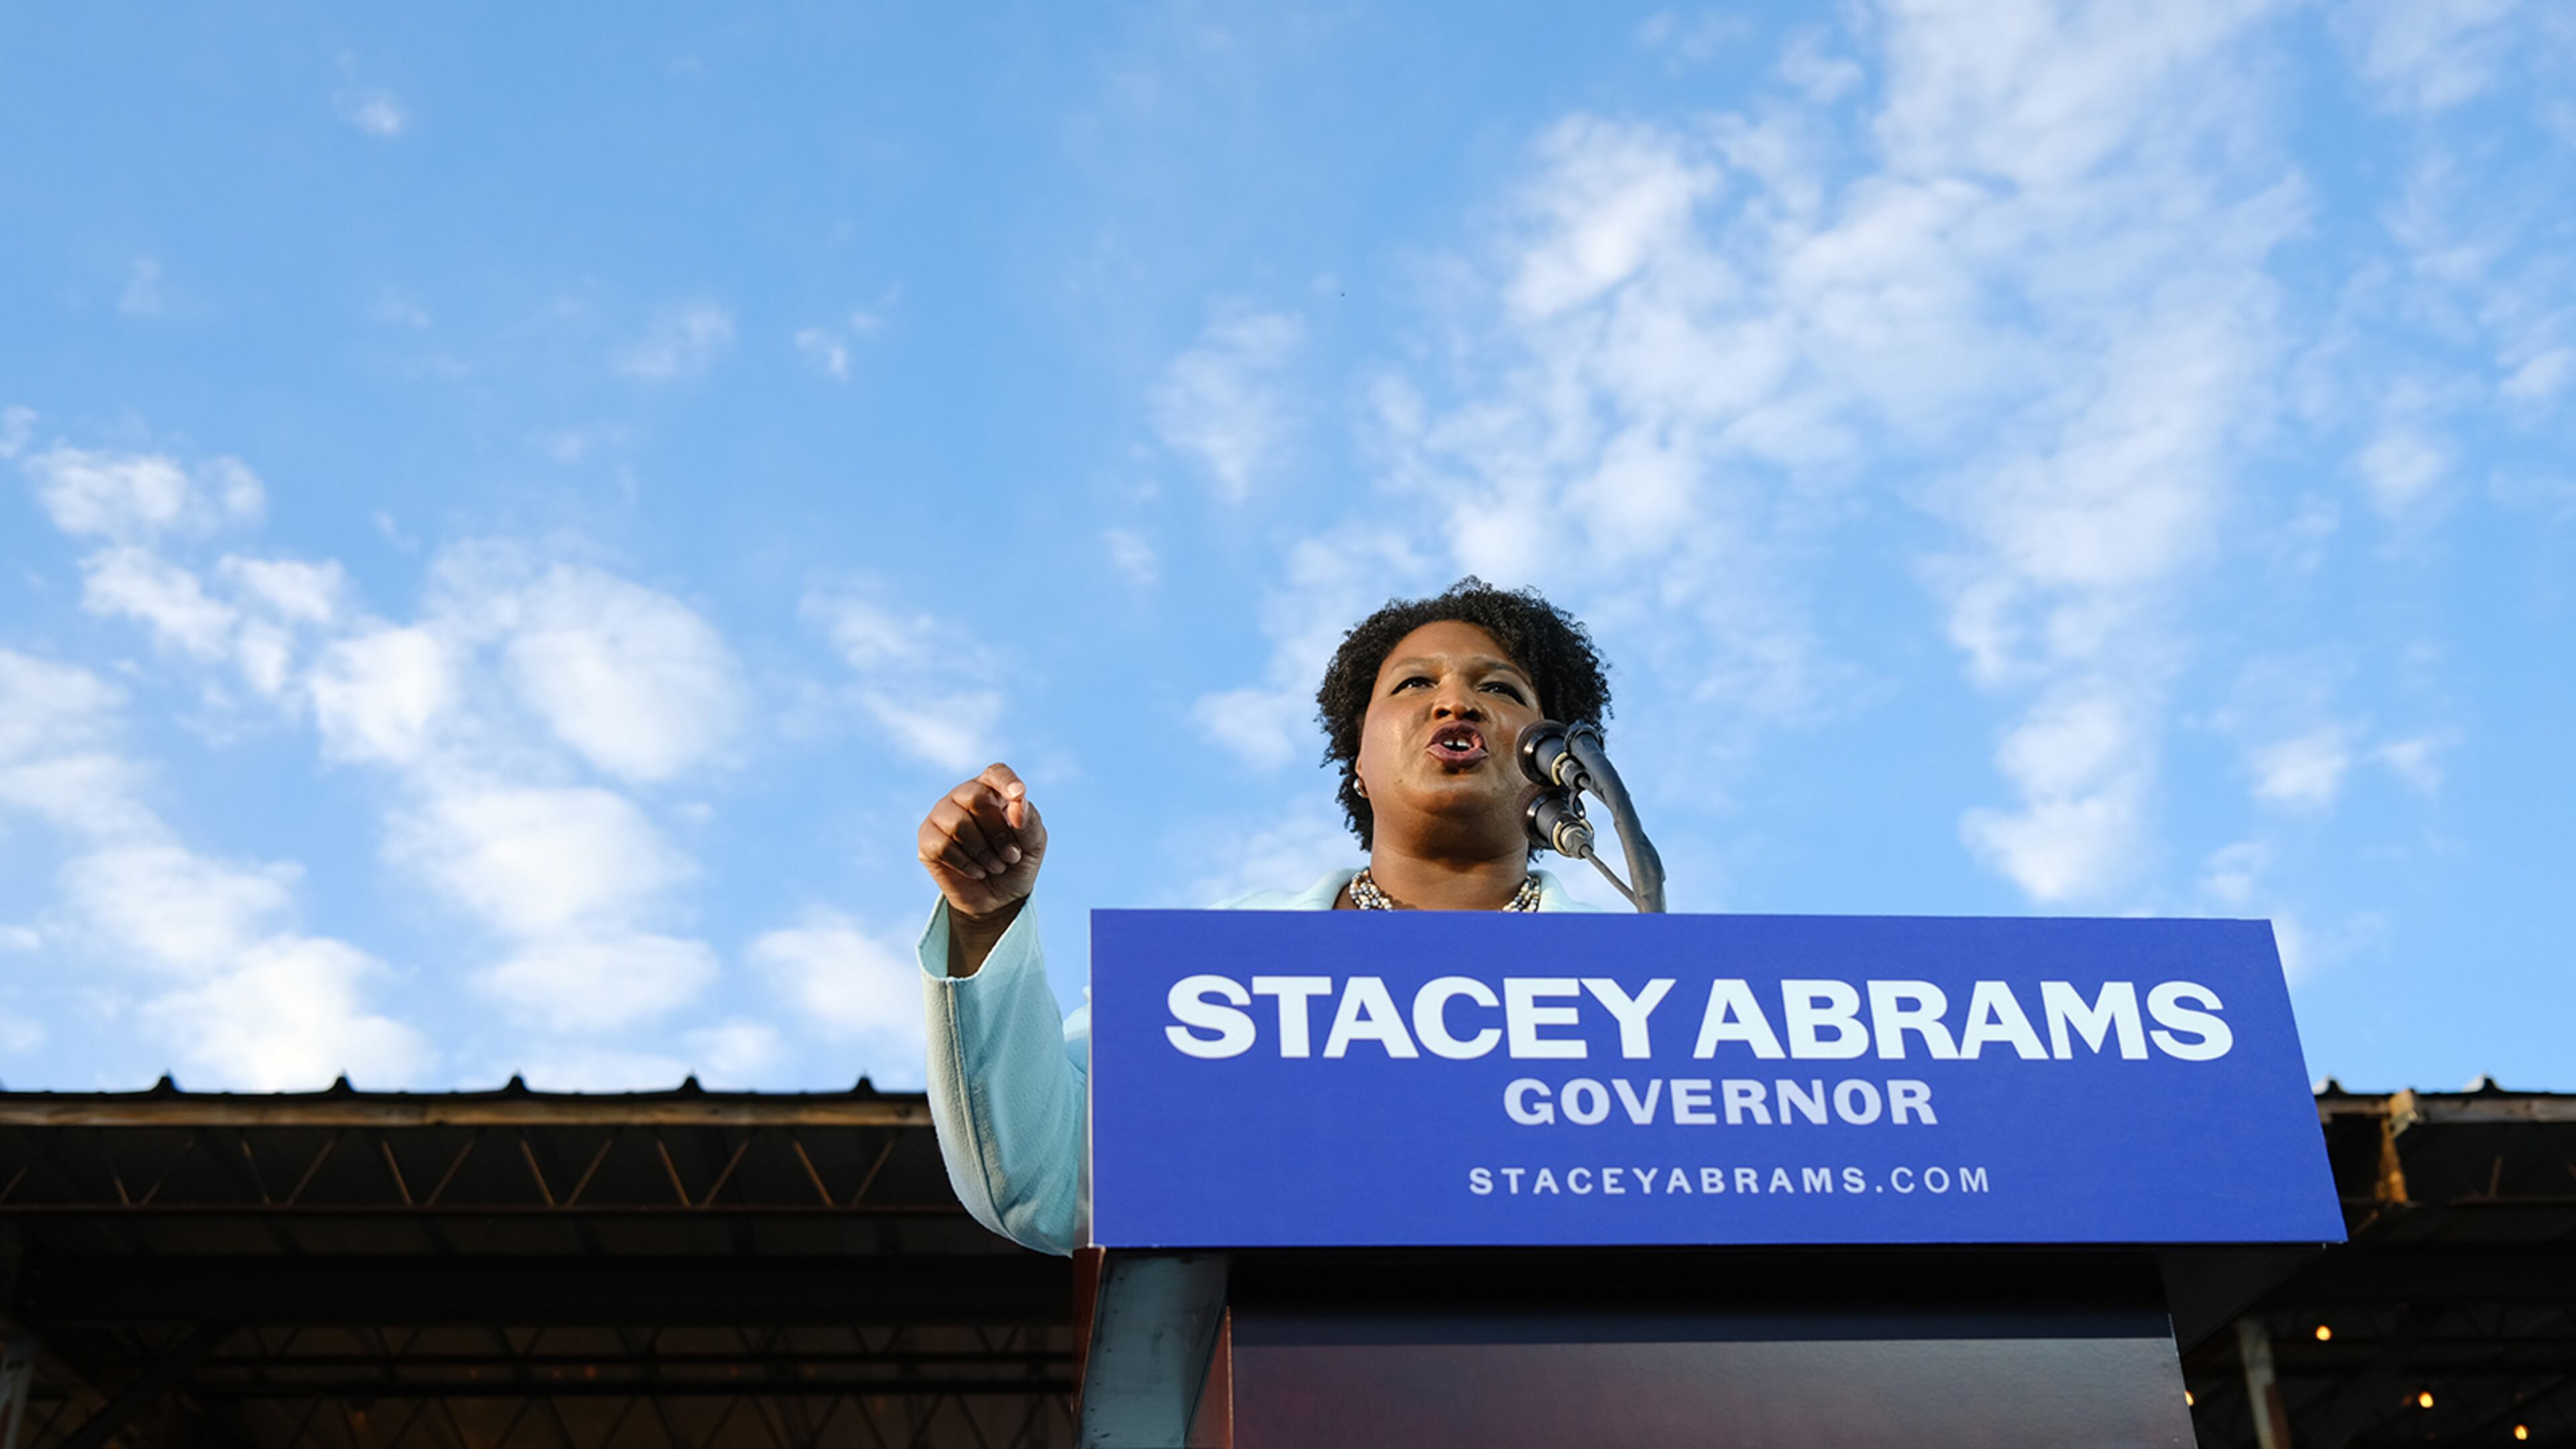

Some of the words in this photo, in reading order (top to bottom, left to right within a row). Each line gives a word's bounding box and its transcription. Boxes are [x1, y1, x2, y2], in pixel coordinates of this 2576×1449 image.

[1165, 975, 1676, 1059] STACEY
[1693, 979, 2233, 1062] ABRAMS
[1504, 1078, 1938, 1125] GOVERNOR
[1469, 1166, 1990, 1195] STACEYABRAMS.COM
